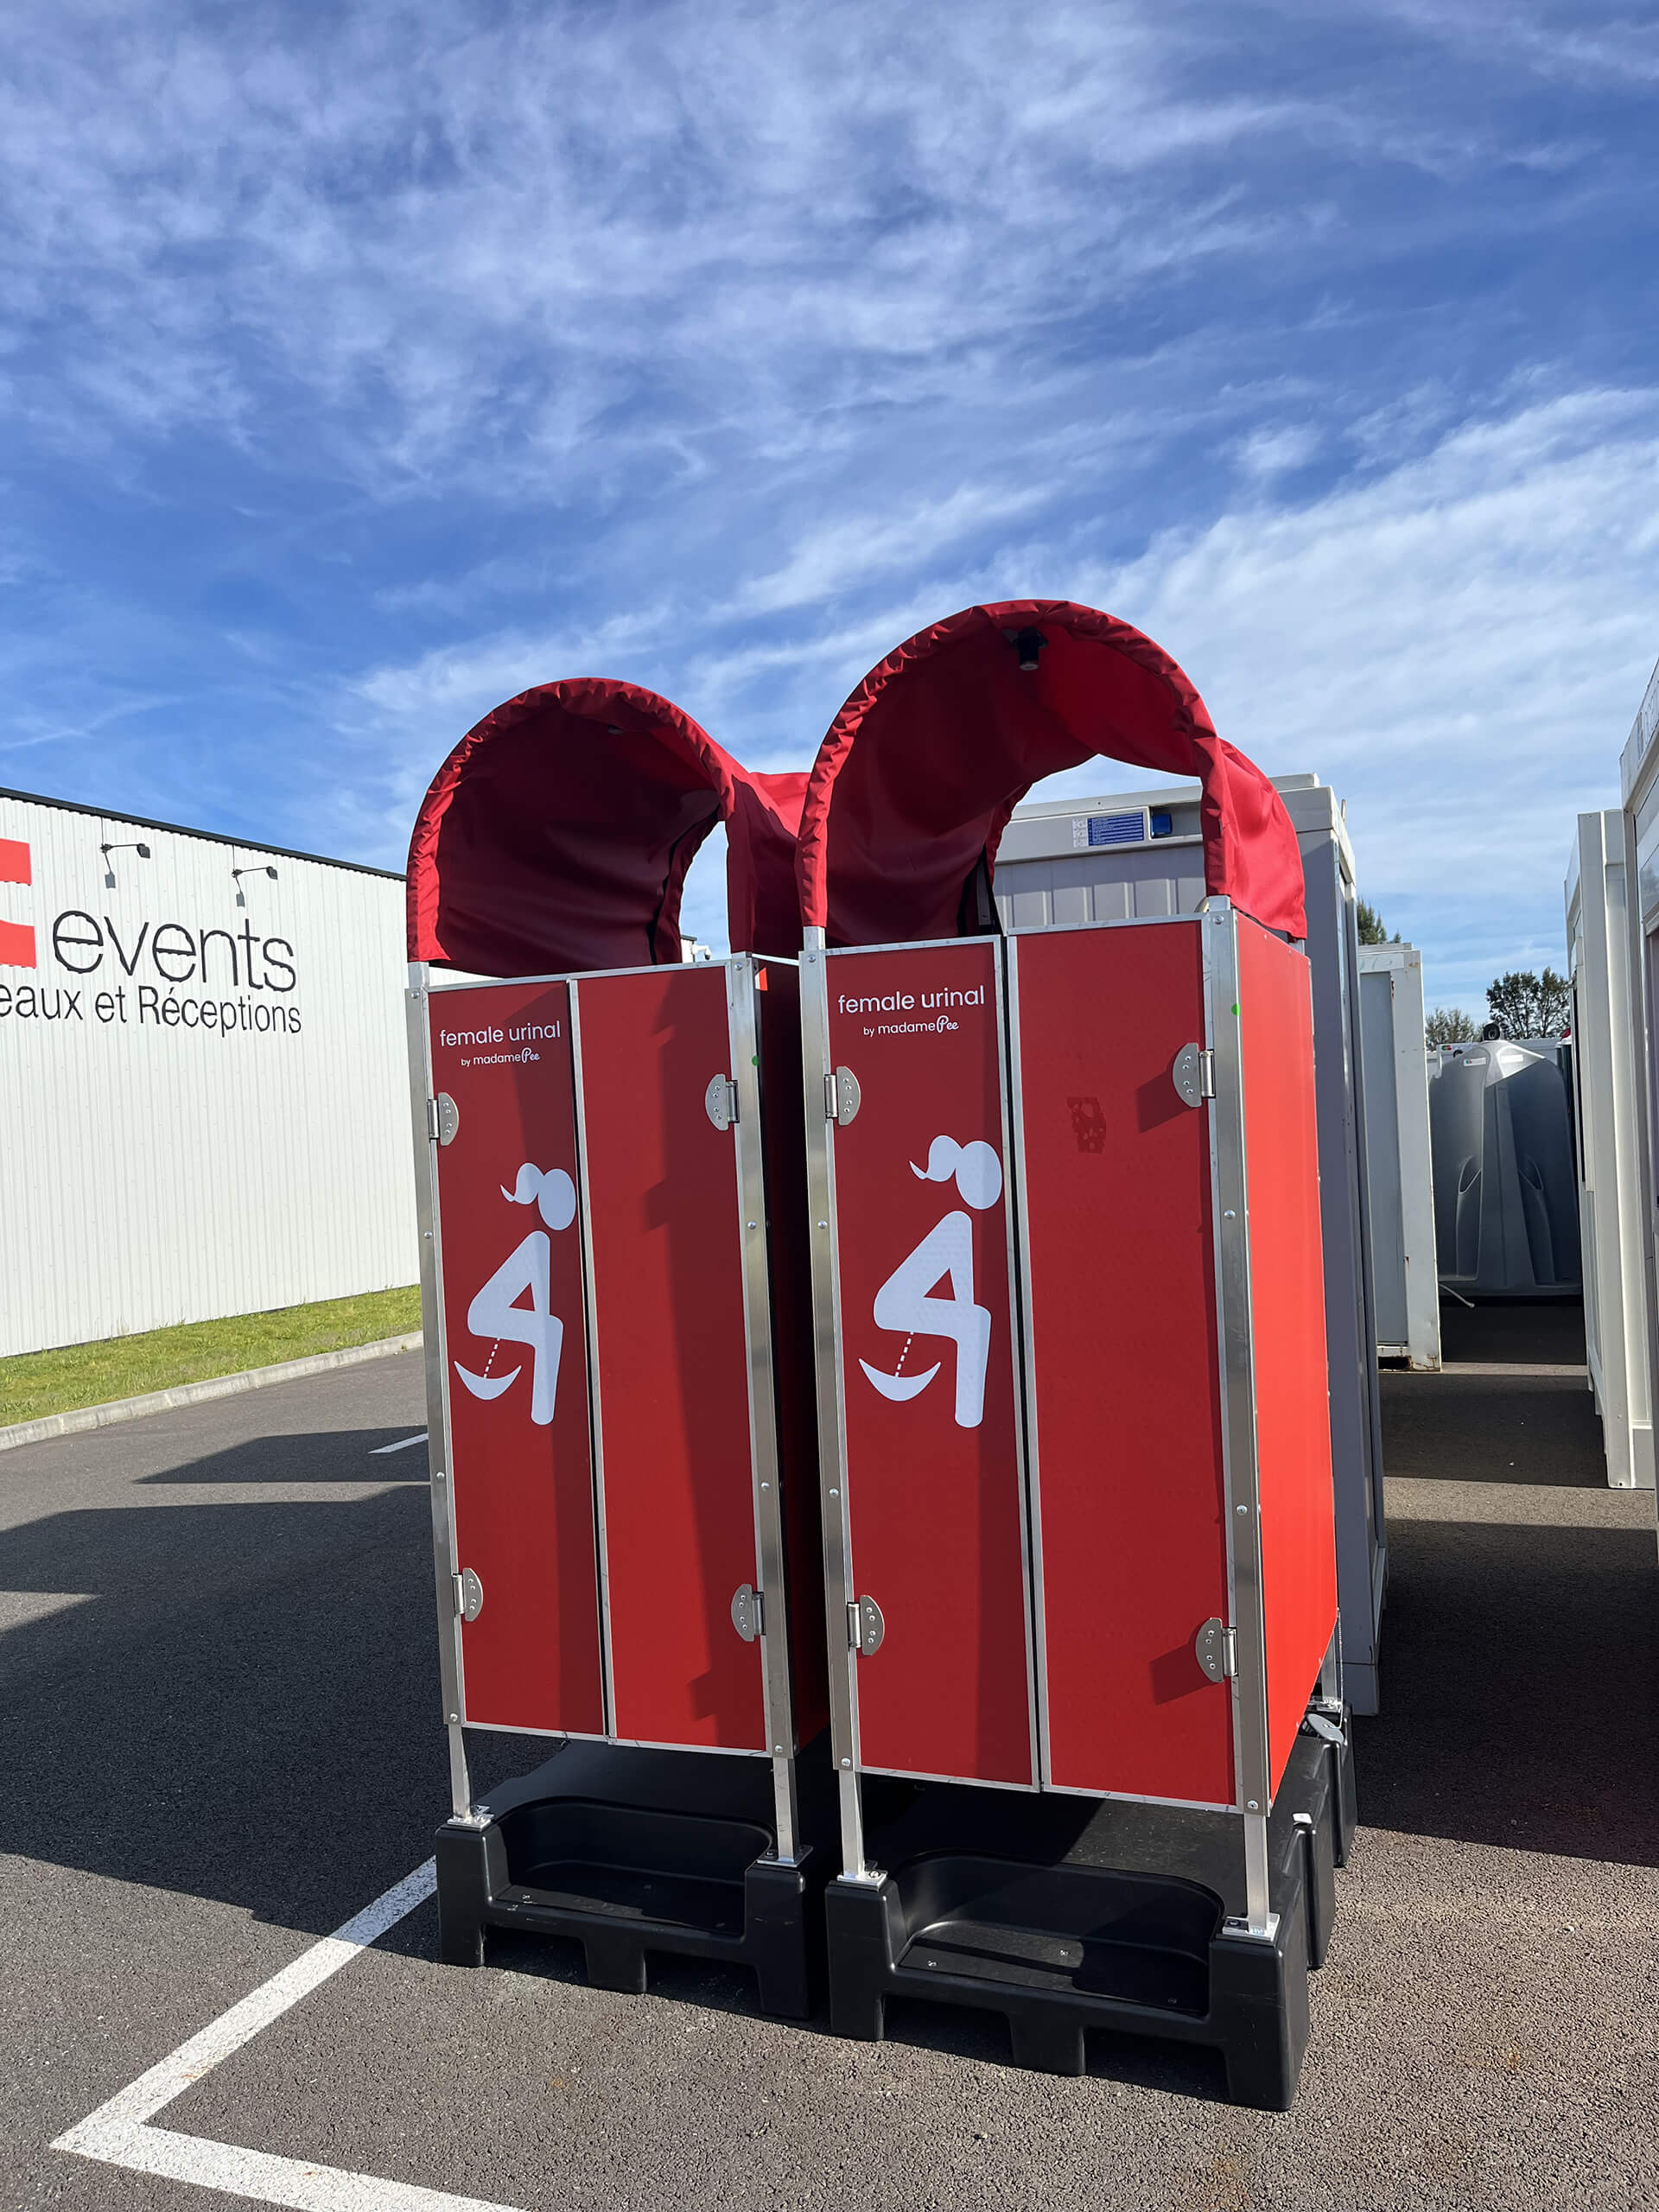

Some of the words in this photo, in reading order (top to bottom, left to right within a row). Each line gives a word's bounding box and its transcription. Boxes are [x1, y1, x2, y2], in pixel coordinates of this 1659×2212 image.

[53, 911, 296, 992] events
[95, 986, 127, 1023] et
[138, 986, 302, 1038] Réceptions
[838, 990, 915, 1014] female
[921, 985, 985, 1008] urinal
[439, 1026, 504, 1047] female
[508, 1020, 561, 1041] urinal
[863, 1027, 875, 1038] by
[461, 1058, 471, 1068] by
